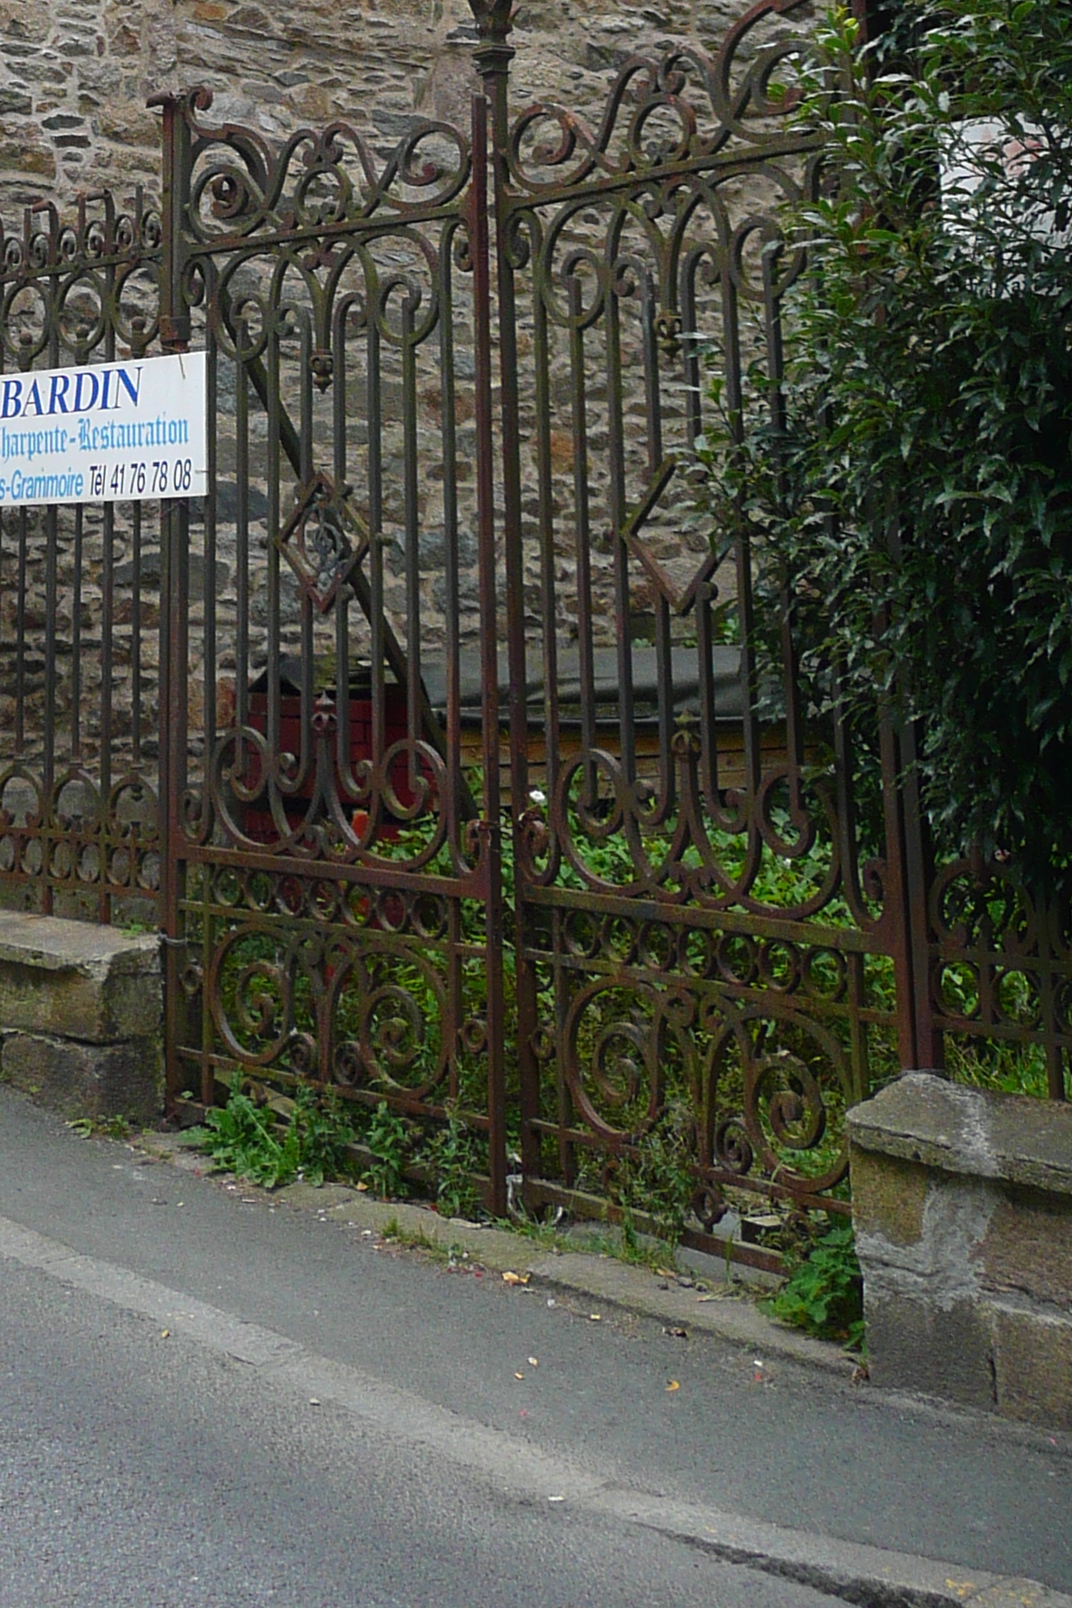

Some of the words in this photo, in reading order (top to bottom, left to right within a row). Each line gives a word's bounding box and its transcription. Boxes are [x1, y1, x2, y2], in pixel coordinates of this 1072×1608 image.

[89, 464, 107, 496] Tél
[110, 463, 126, 495] 41
[129, 462, 146, 494] 76
[151, 460, 168, 493] 78
[173, 458, 192, 491] 08
